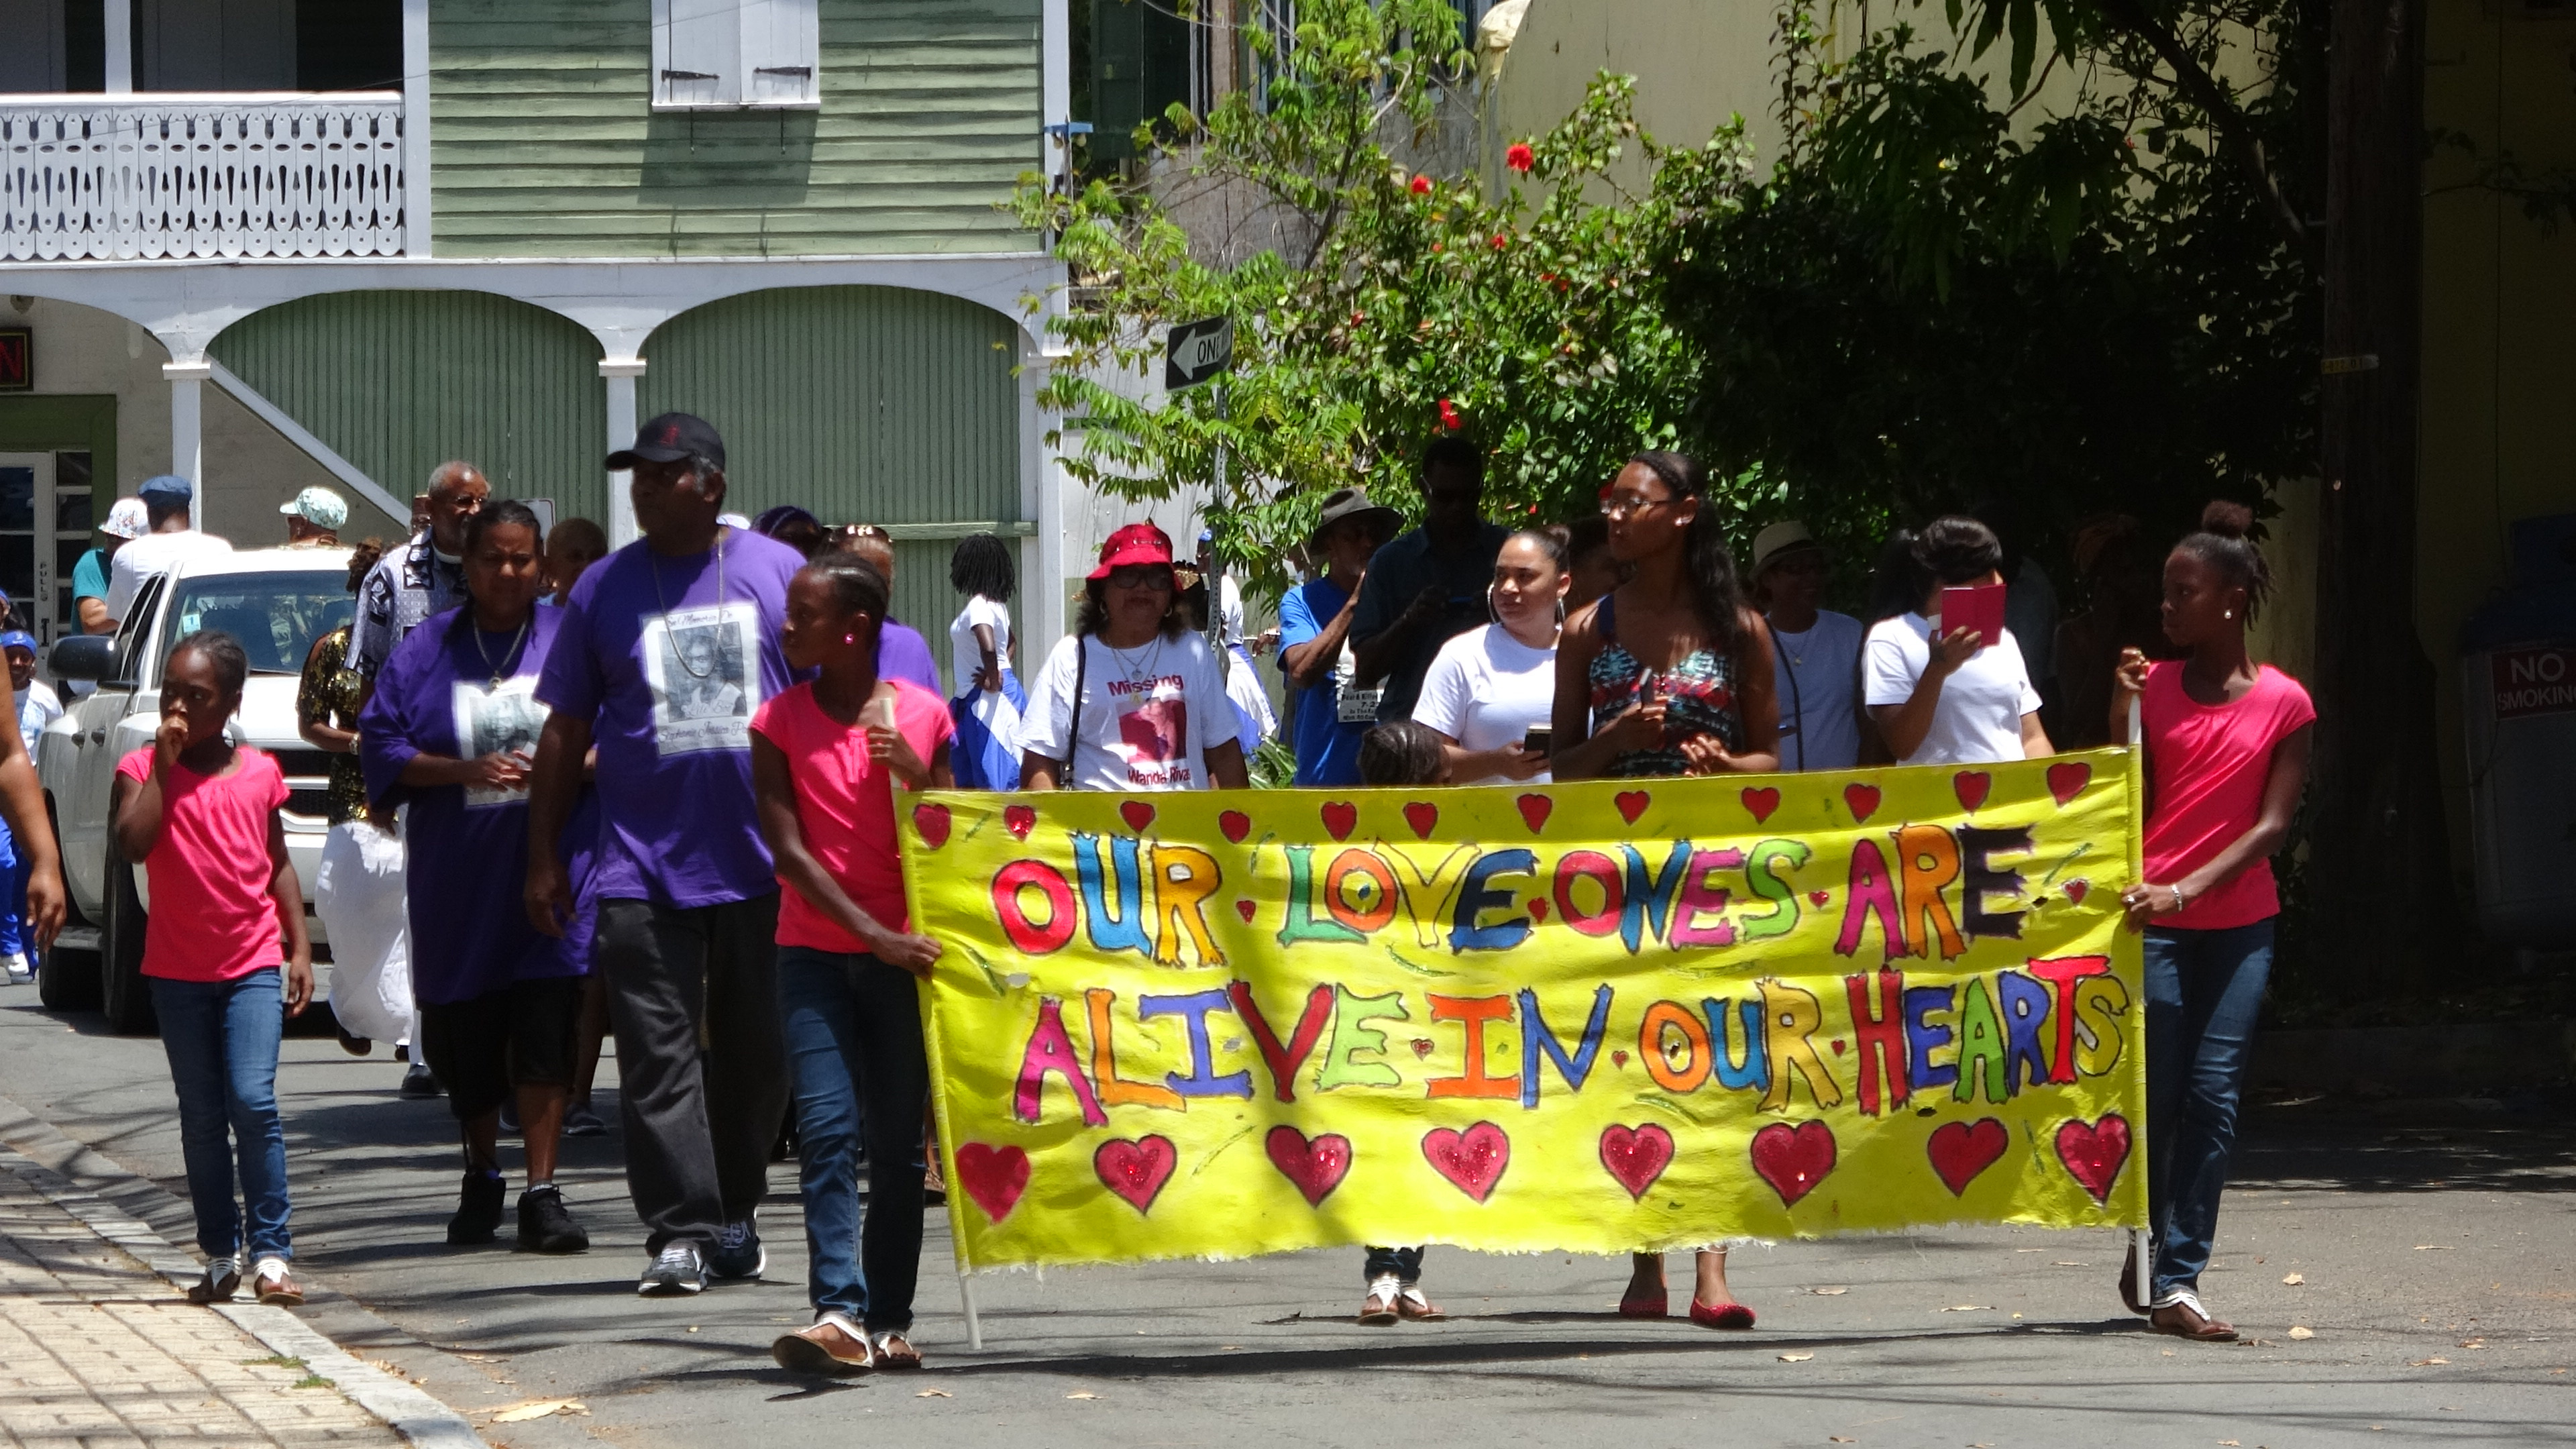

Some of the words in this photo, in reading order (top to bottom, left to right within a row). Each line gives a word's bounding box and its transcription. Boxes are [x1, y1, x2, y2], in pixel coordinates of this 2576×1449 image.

[2511, 654, 2565, 684] NO
[1107, 674, 1184, 697] Missing
[2498, 686, 2576, 711] SMOKIN
[1128, 769, 1167, 786] Wanda
[992, 830, 1228, 968] OUR
[1277, 837, 1540, 954] LOVE
[1553, 837, 1813, 954] ONES
[1834, 823, 2037, 961] ARE
[1013, 979, 1411, 1128] ALIVE
[1425, 983, 1614, 1110] IN
[1638, 976, 1843, 1112] OUR
[1845, 956, 2130, 1116] HEARTS
